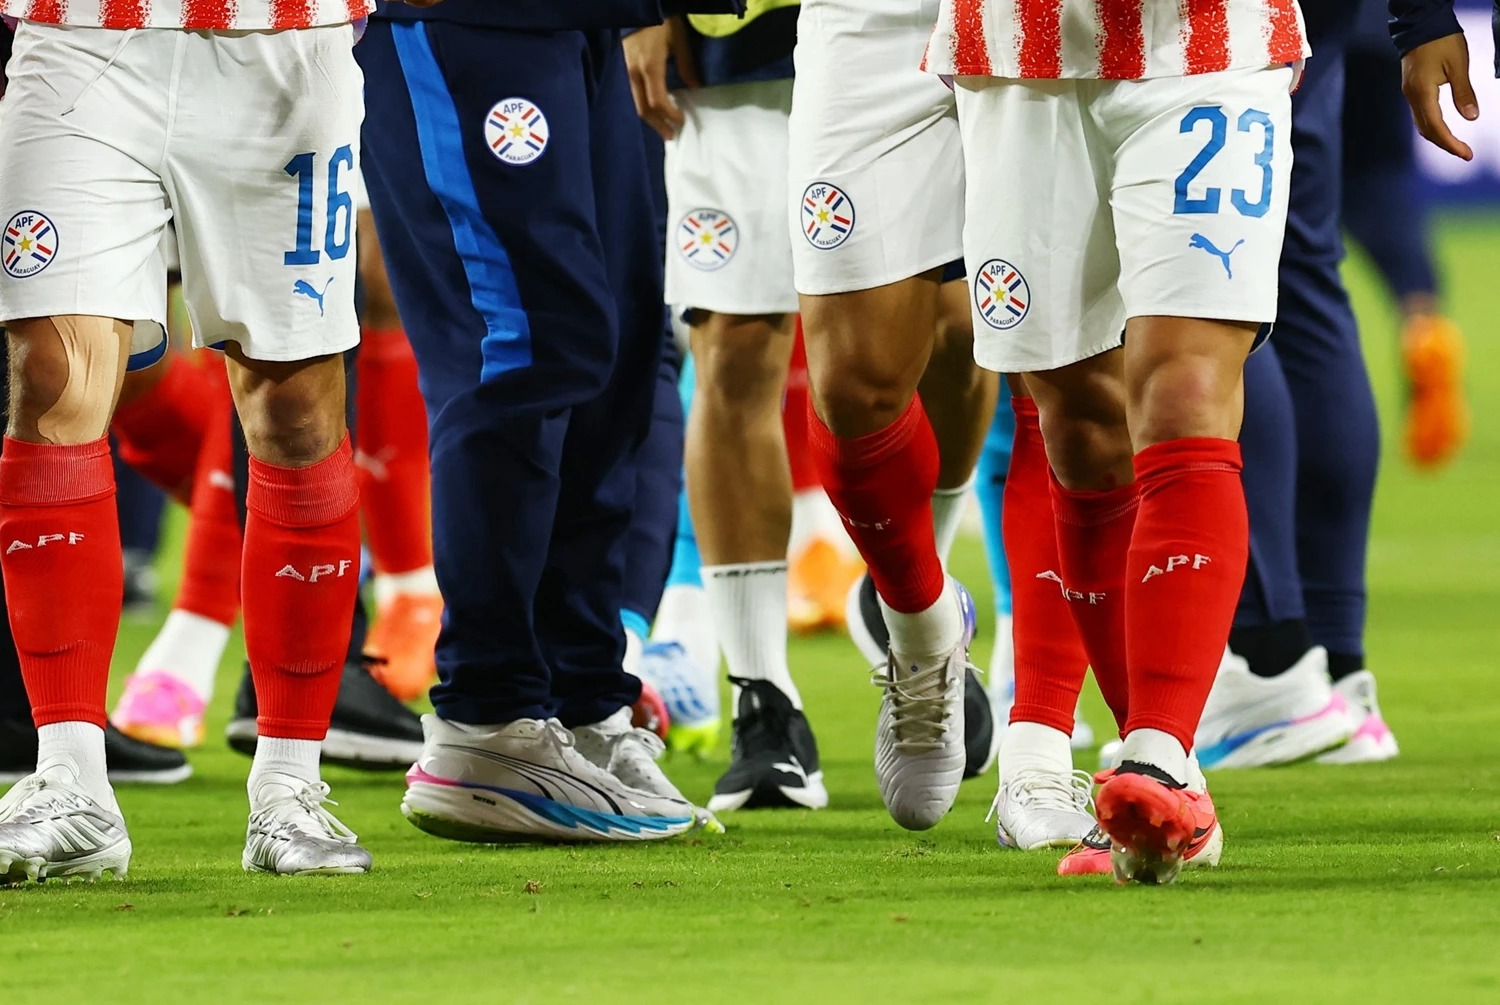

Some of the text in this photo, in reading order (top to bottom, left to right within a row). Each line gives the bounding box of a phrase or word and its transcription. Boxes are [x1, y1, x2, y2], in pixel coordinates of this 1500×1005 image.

[503, 102, 524, 114] APF
[504, 151, 535, 162] PARAGUAY
[1173, 105, 1274, 219] 23
[810, 186, 827, 200] APF
[282, 143, 354, 267] 16
[15, 215, 34, 229] APF
[815, 233, 842, 246] PARAGUAY
[13, 263, 41, 274] PARAGUAY
[989, 264, 1006, 276] APF
[988, 316, 1015, 326] PARAGUAY
[6, 531, 85, 555] APF
[275, 559, 352, 583] APF
[1142, 553, 1212, 583] APF
